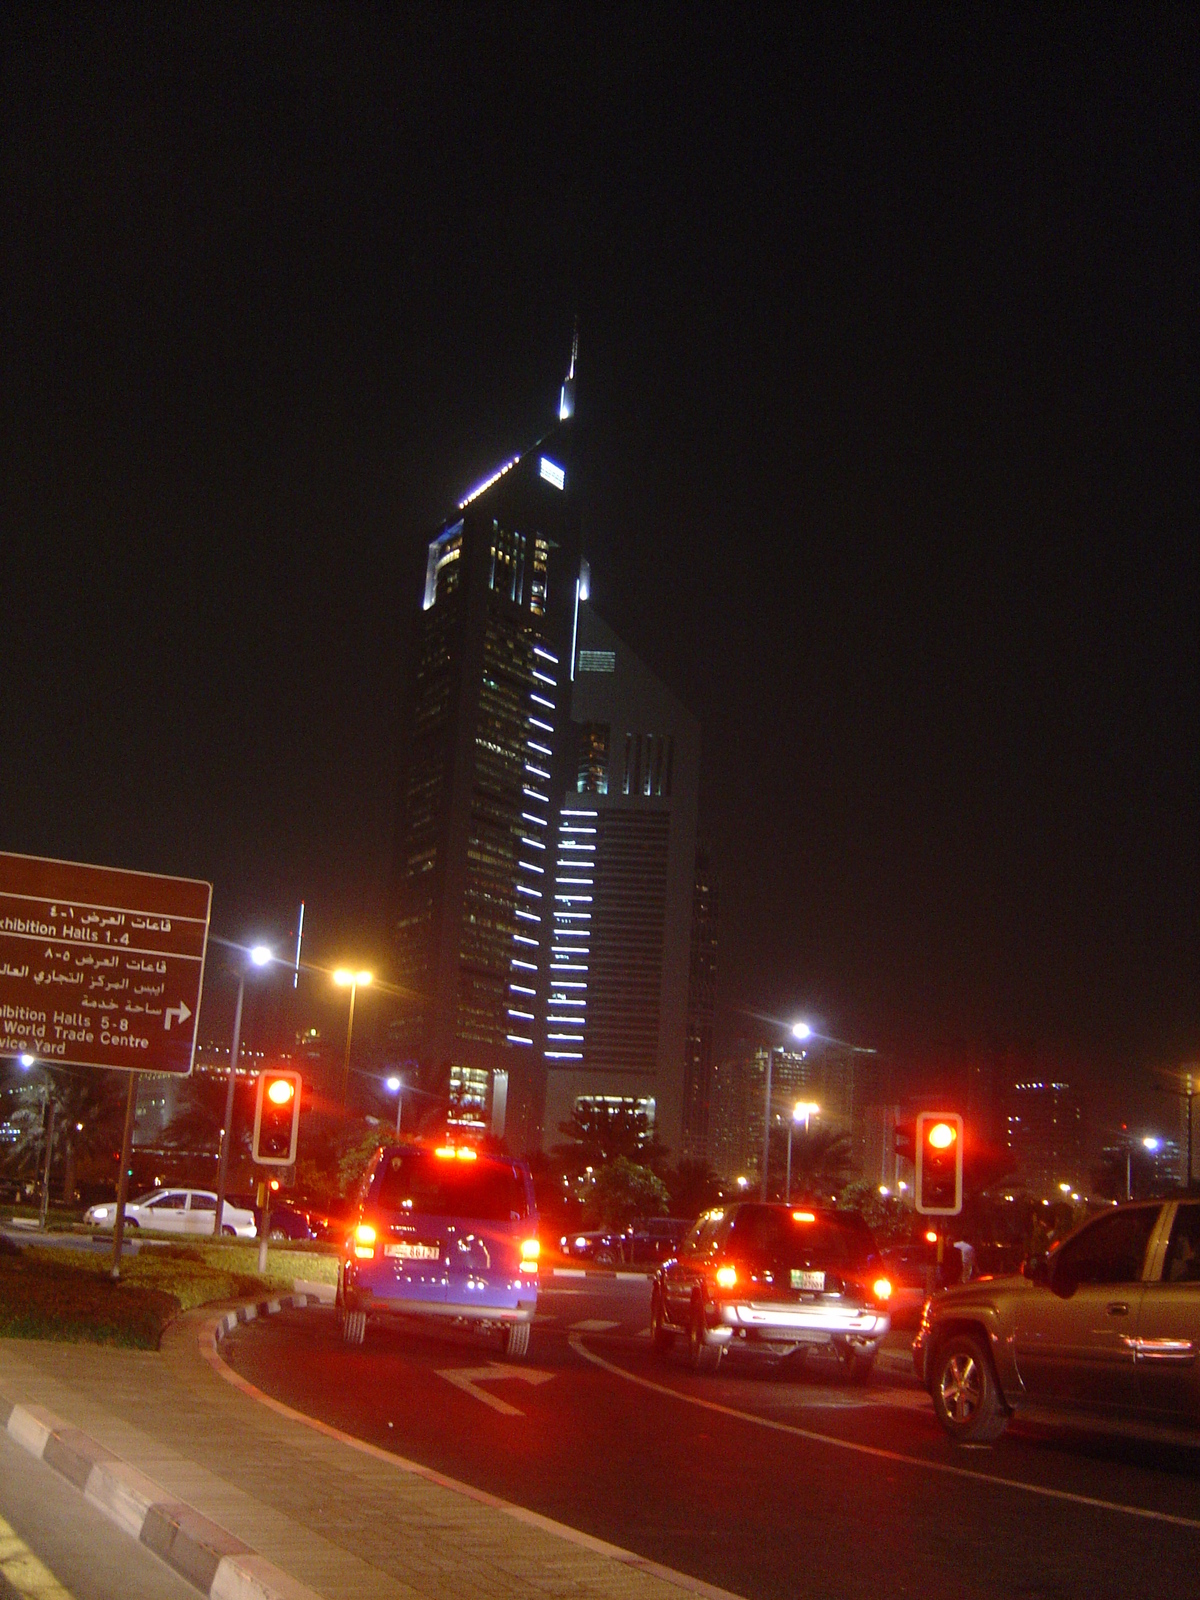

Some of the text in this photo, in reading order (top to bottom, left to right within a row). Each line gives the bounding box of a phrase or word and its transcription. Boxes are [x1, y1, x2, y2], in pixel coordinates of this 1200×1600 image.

[80, 911, 125, 928] العرض
[131, 918, 172, 933] قاعات
[0, 917, 57, 936] xhibition
[62, 924, 98, 942] Halls
[75, 956, 119, 970] العرض
[126, 960, 167, 974] قاعات
[34, 972, 84, 986] التجاري
[89, 974, 129, 990] المركز
[0, 1004, 46, 1023] ibition
[53, 1010, 91, 1028] Halls
[4, 1020, 149, 1049] World Trade Centre
[0, 1036, 66, 1055] vice Yard
